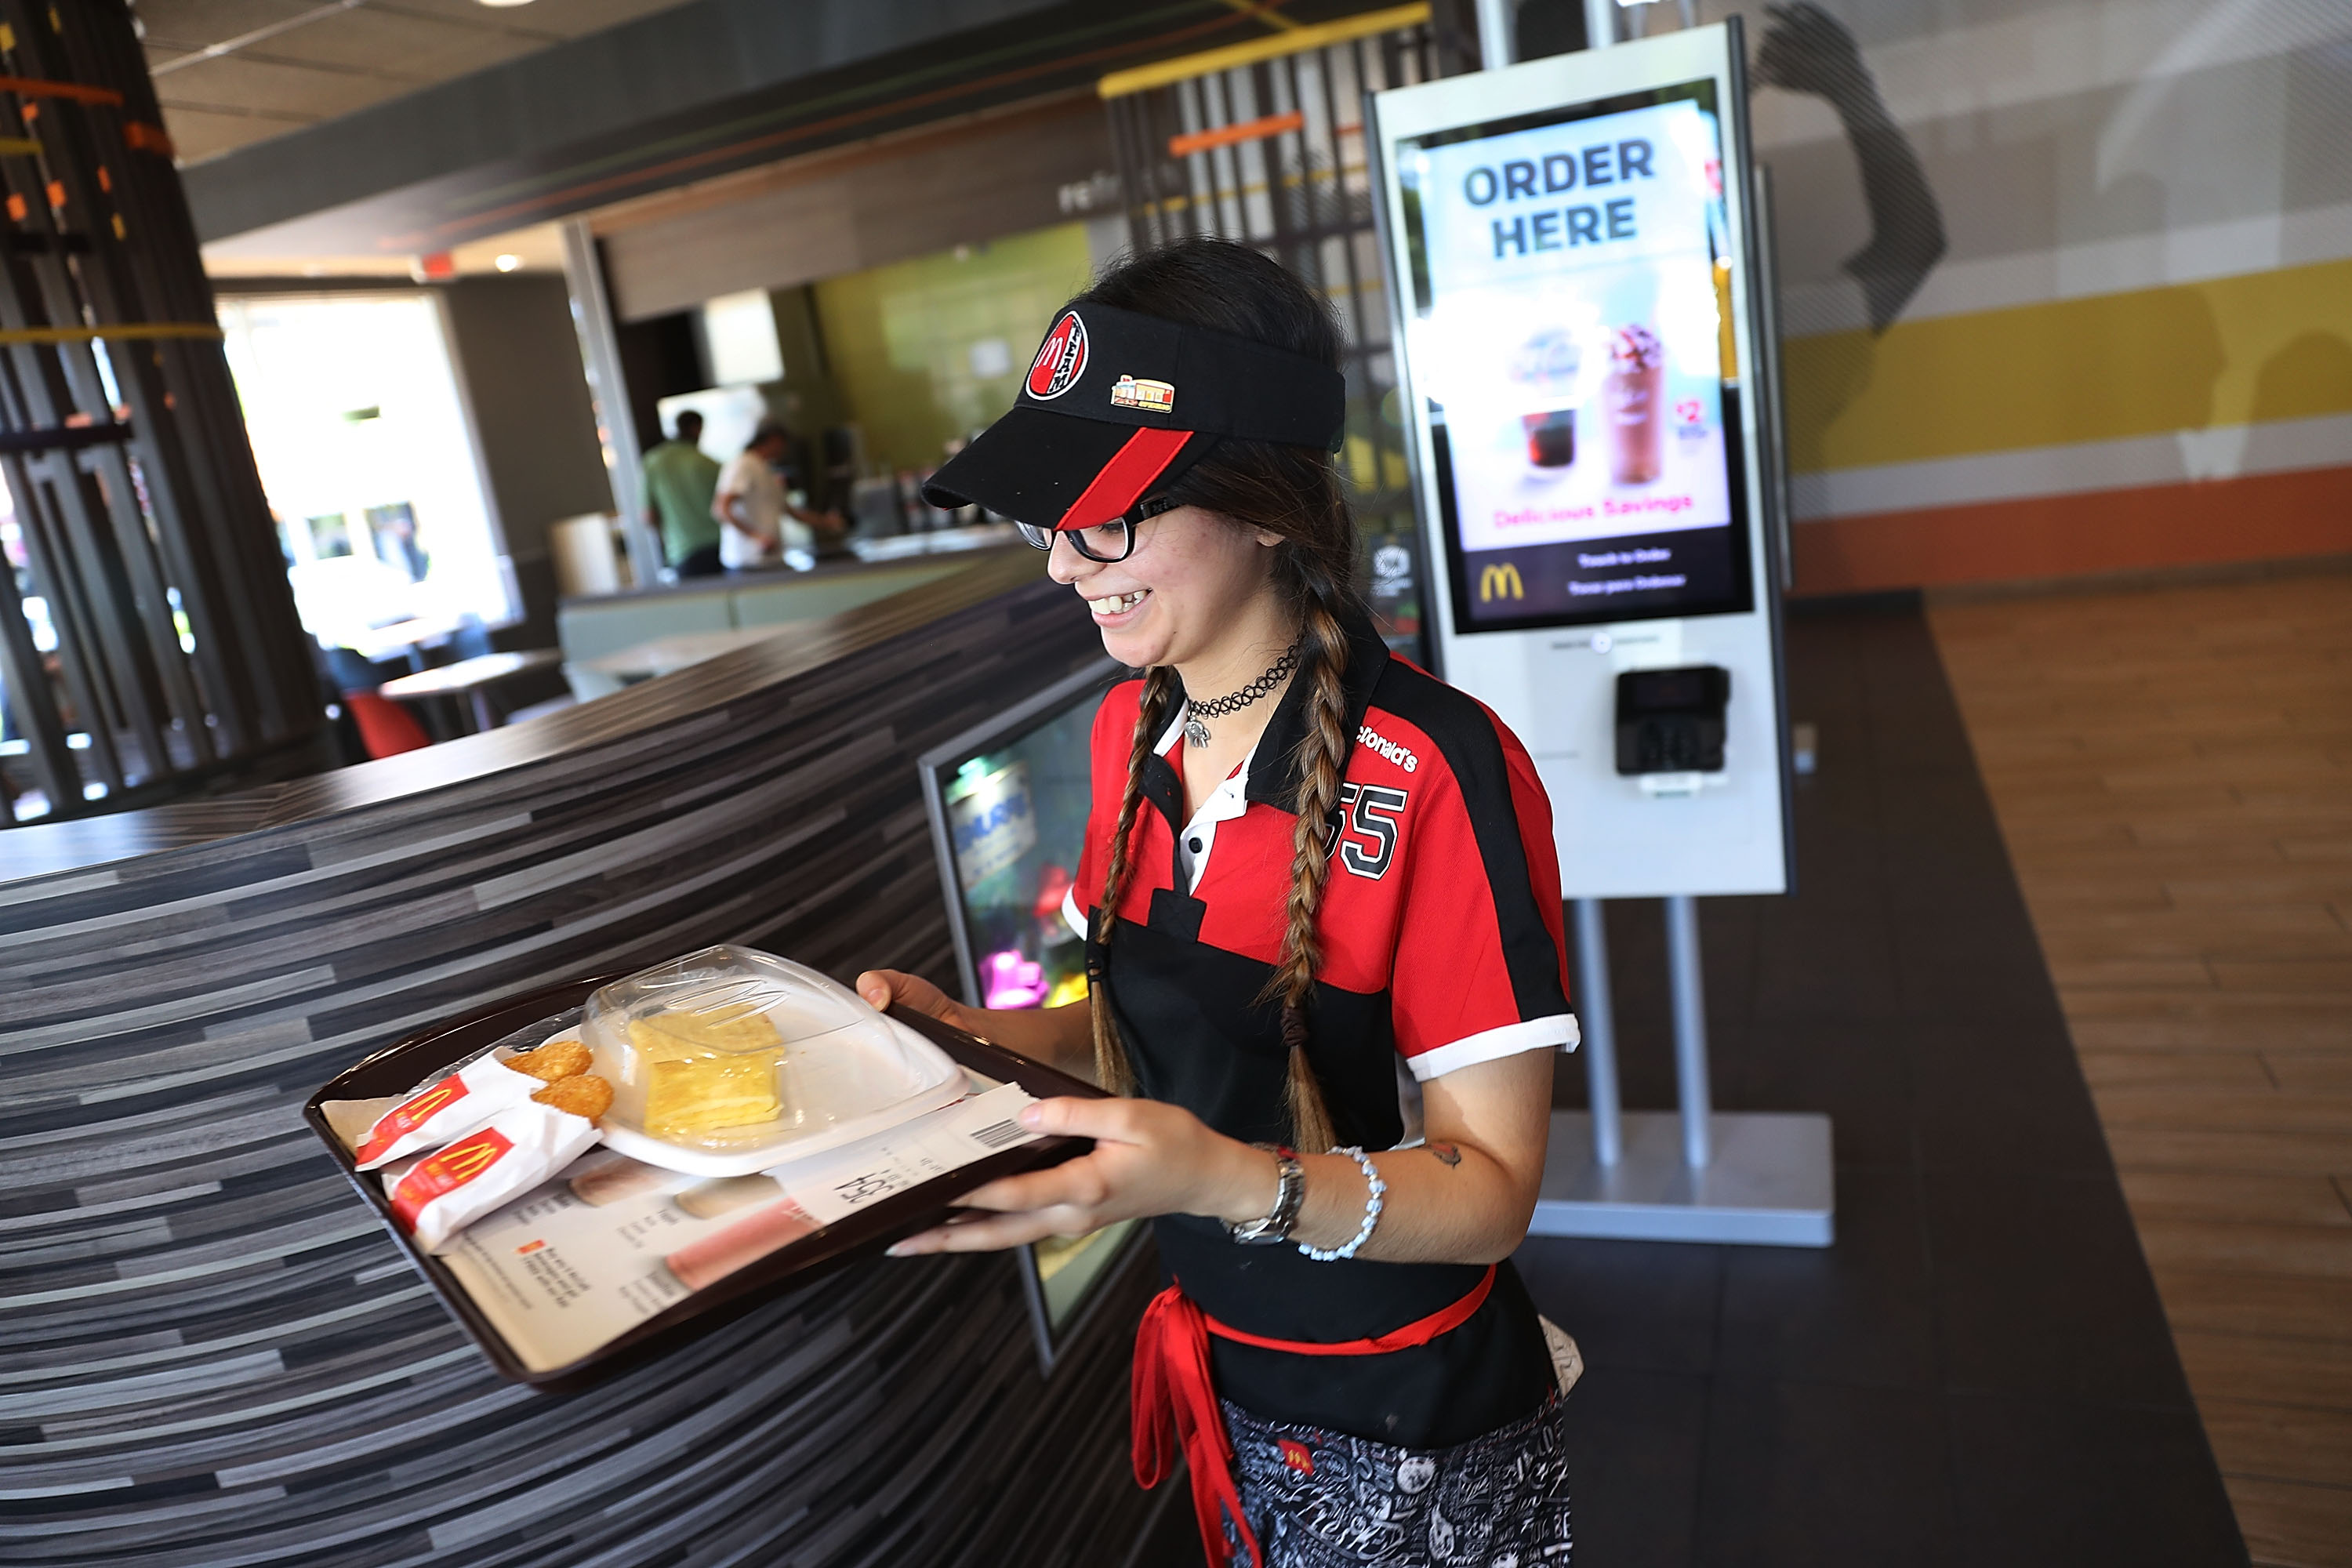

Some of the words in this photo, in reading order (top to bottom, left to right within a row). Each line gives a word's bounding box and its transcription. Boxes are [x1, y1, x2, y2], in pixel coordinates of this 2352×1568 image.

[1465, 140, 1653, 205] ORDER
[1493, 198, 1635, 258] HERE
[1603, 495, 1694, 518] Savings
